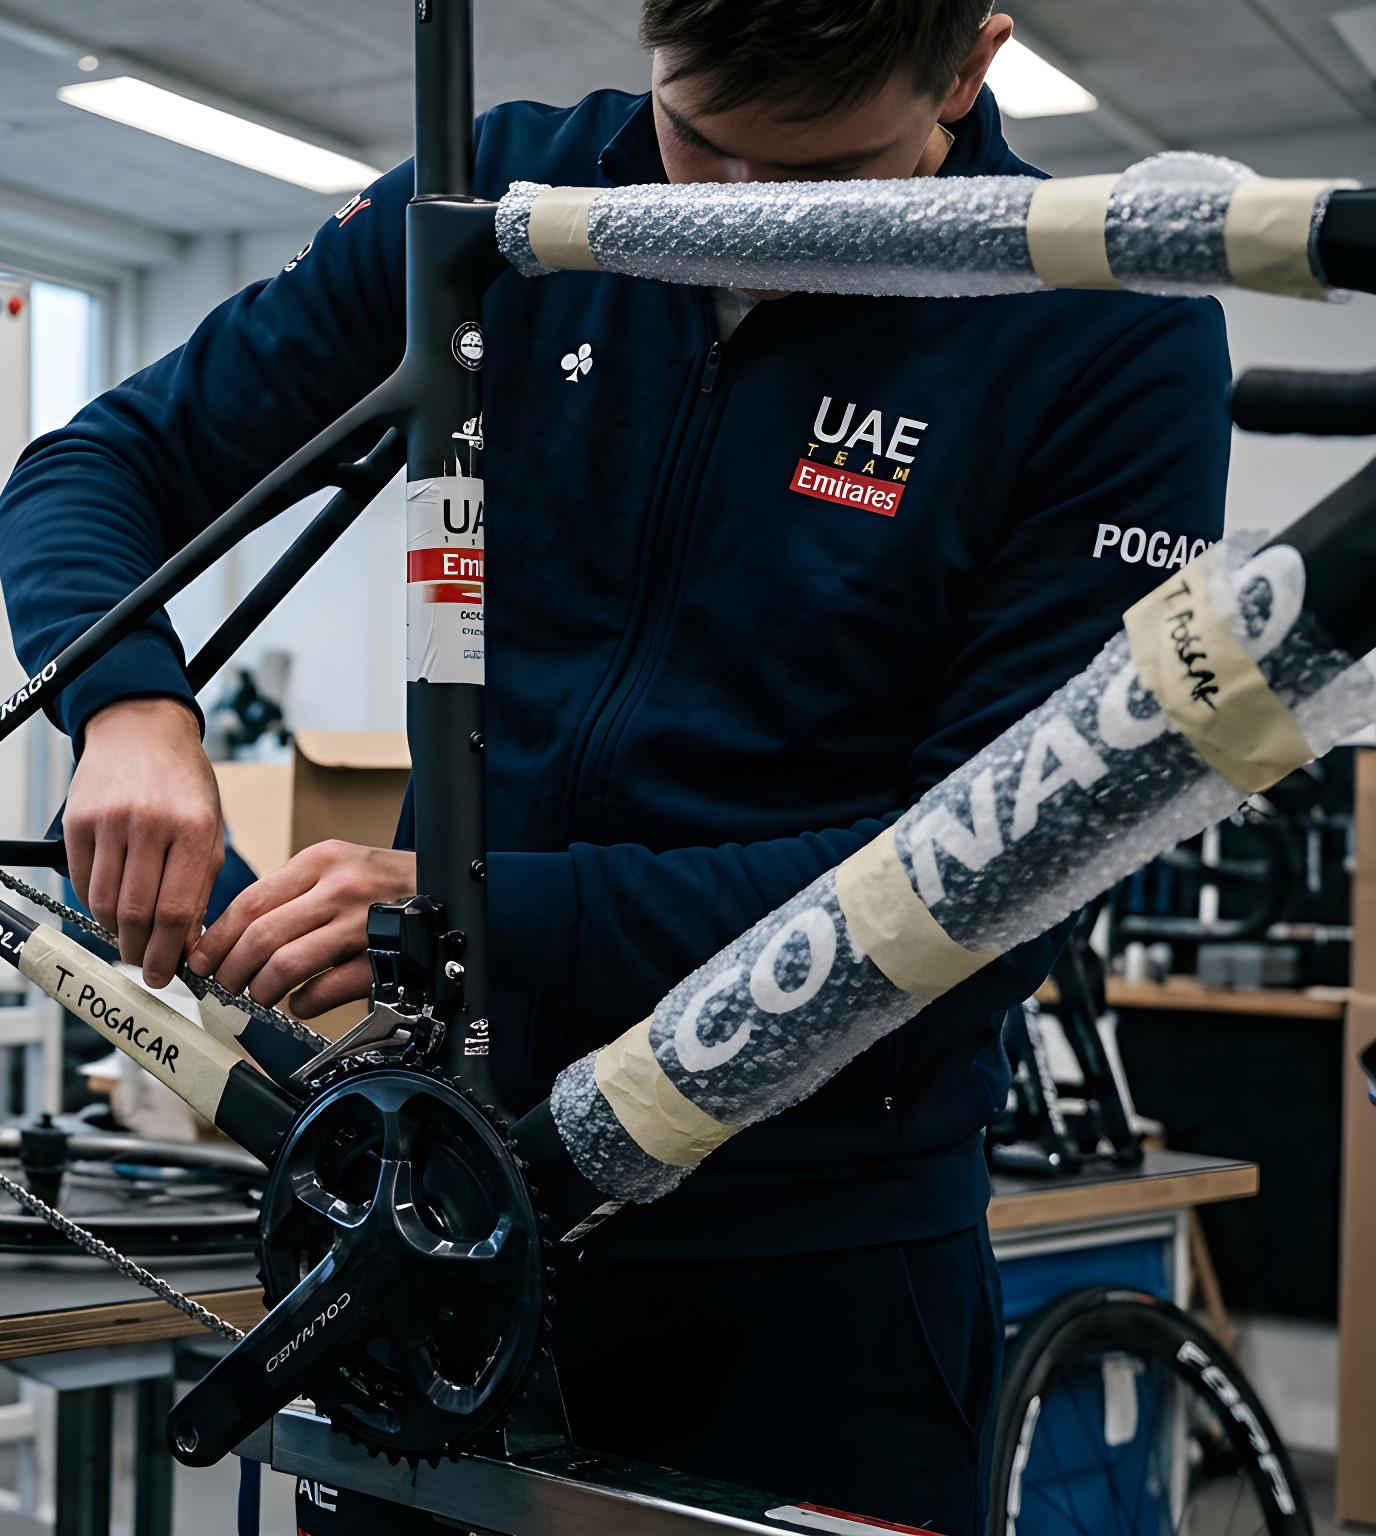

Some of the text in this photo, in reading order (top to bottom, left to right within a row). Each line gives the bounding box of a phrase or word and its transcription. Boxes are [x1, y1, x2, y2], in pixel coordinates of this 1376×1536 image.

[813, 395, 929, 465] UAE
[55, 964, 180, 1074] T. POGACAR
